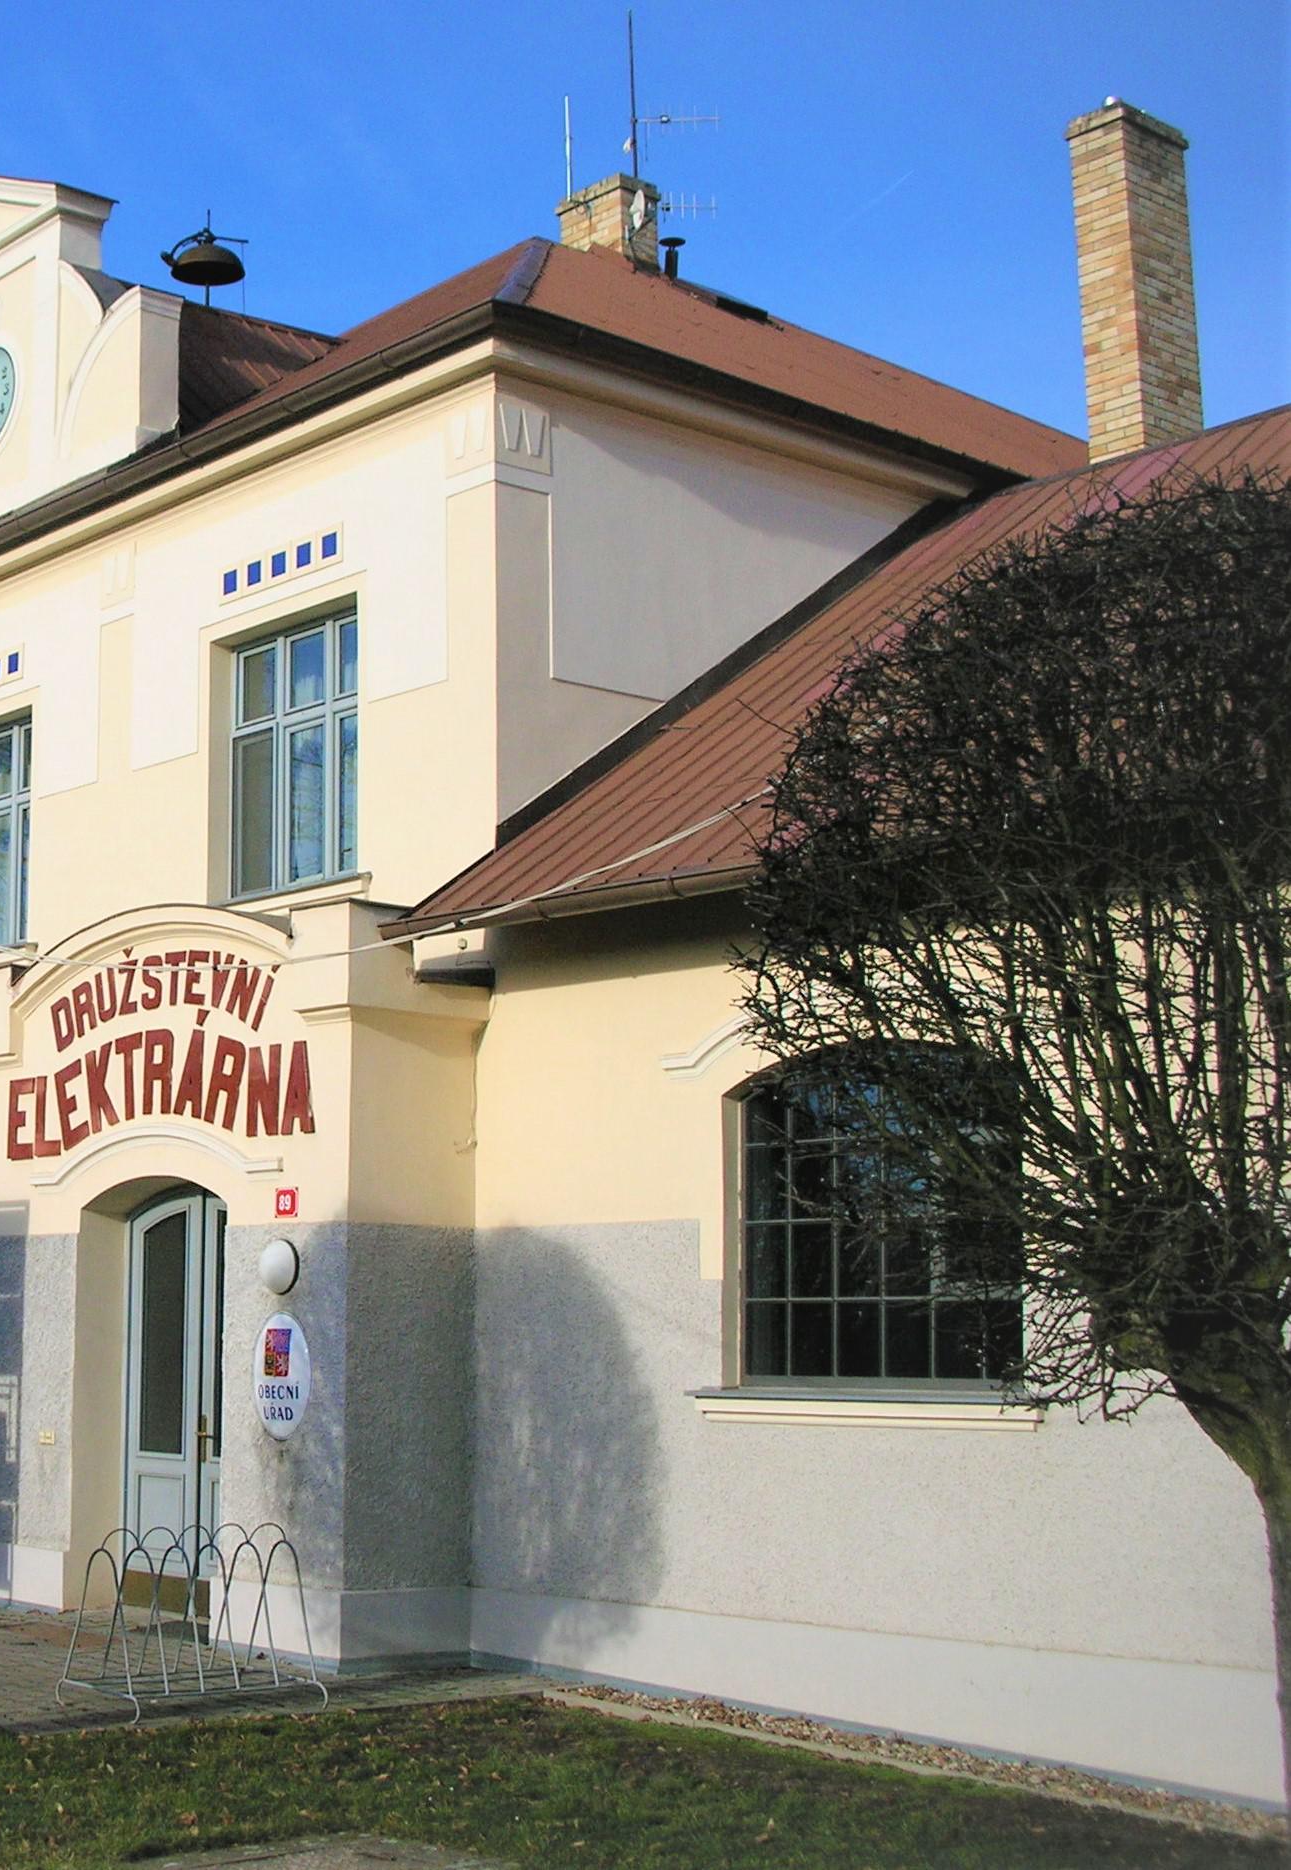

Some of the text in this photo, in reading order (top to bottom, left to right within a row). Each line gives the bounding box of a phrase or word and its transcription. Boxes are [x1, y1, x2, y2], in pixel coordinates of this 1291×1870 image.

[50, 946, 280, 1053] DRUŽSTEVNÍ
[7, 1009, 316, 1161] ELEKTRÁRNA
[278, 1194, 292, 1211] 89
[258, 1380, 300, 1400] OBECNÍ
